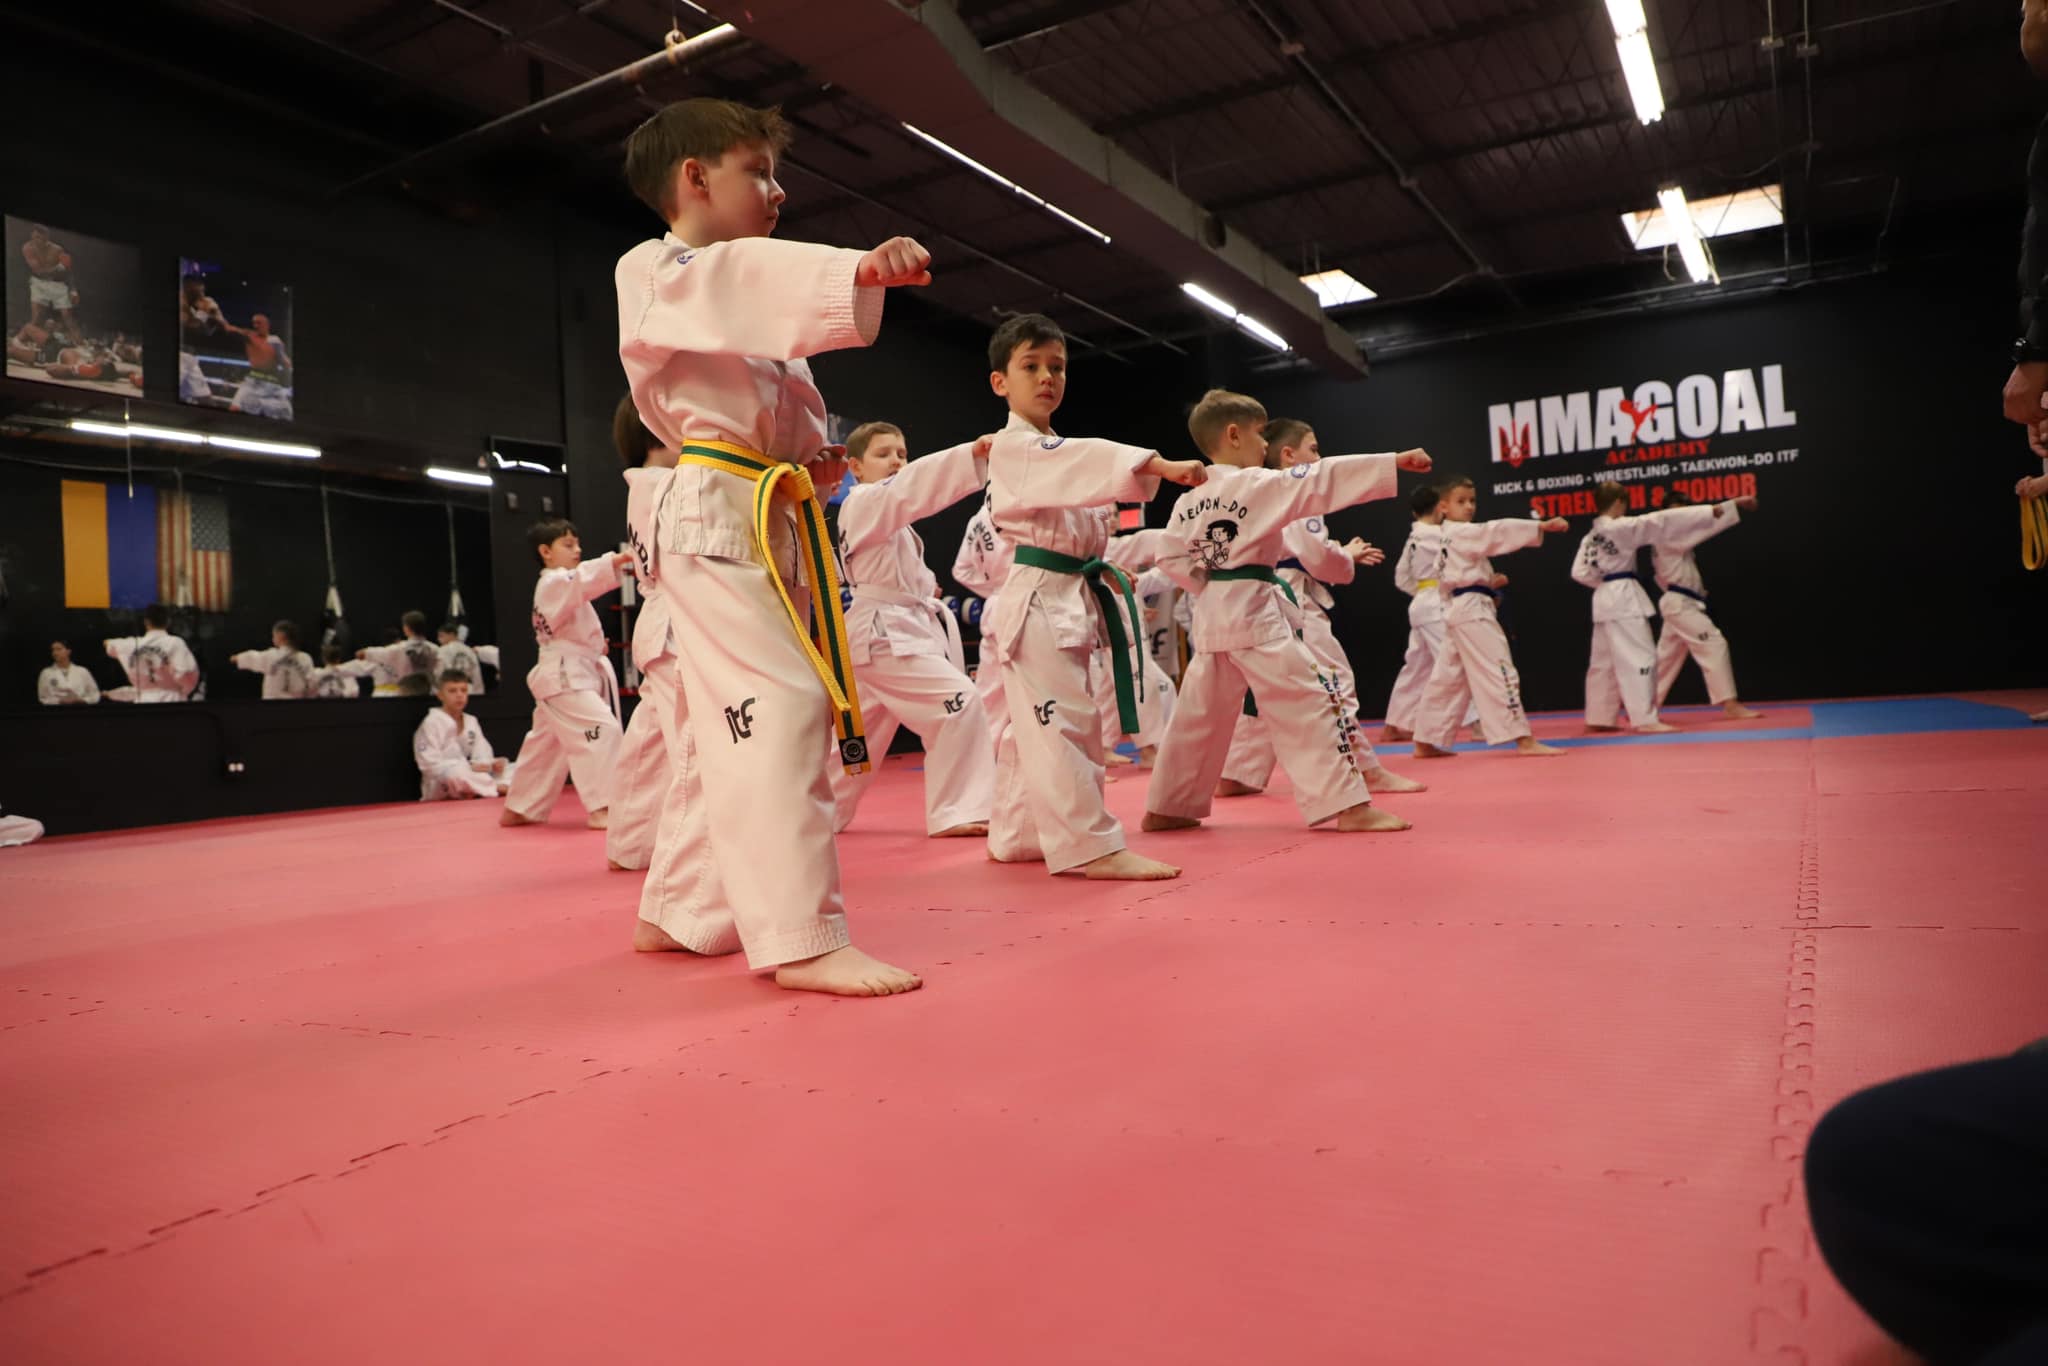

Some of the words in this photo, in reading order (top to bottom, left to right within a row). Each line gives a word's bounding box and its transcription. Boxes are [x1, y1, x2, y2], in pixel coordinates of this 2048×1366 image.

[1488, 364, 1797, 463] MMAGOAL
[1493, 480, 1523, 495] KICK
[1525, 479, 1535, 492] &
[1537, 473, 1585, 491] BOXING
[1593, 463, 1670, 484] WRESTLING
[1680, 451, 1774, 474] TAEKWON-DO
[1777, 448, 1799, 464] ITF
[1605, 438, 1711, 465] ACADEMY
[1529, 484, 1647, 519] STRENH
